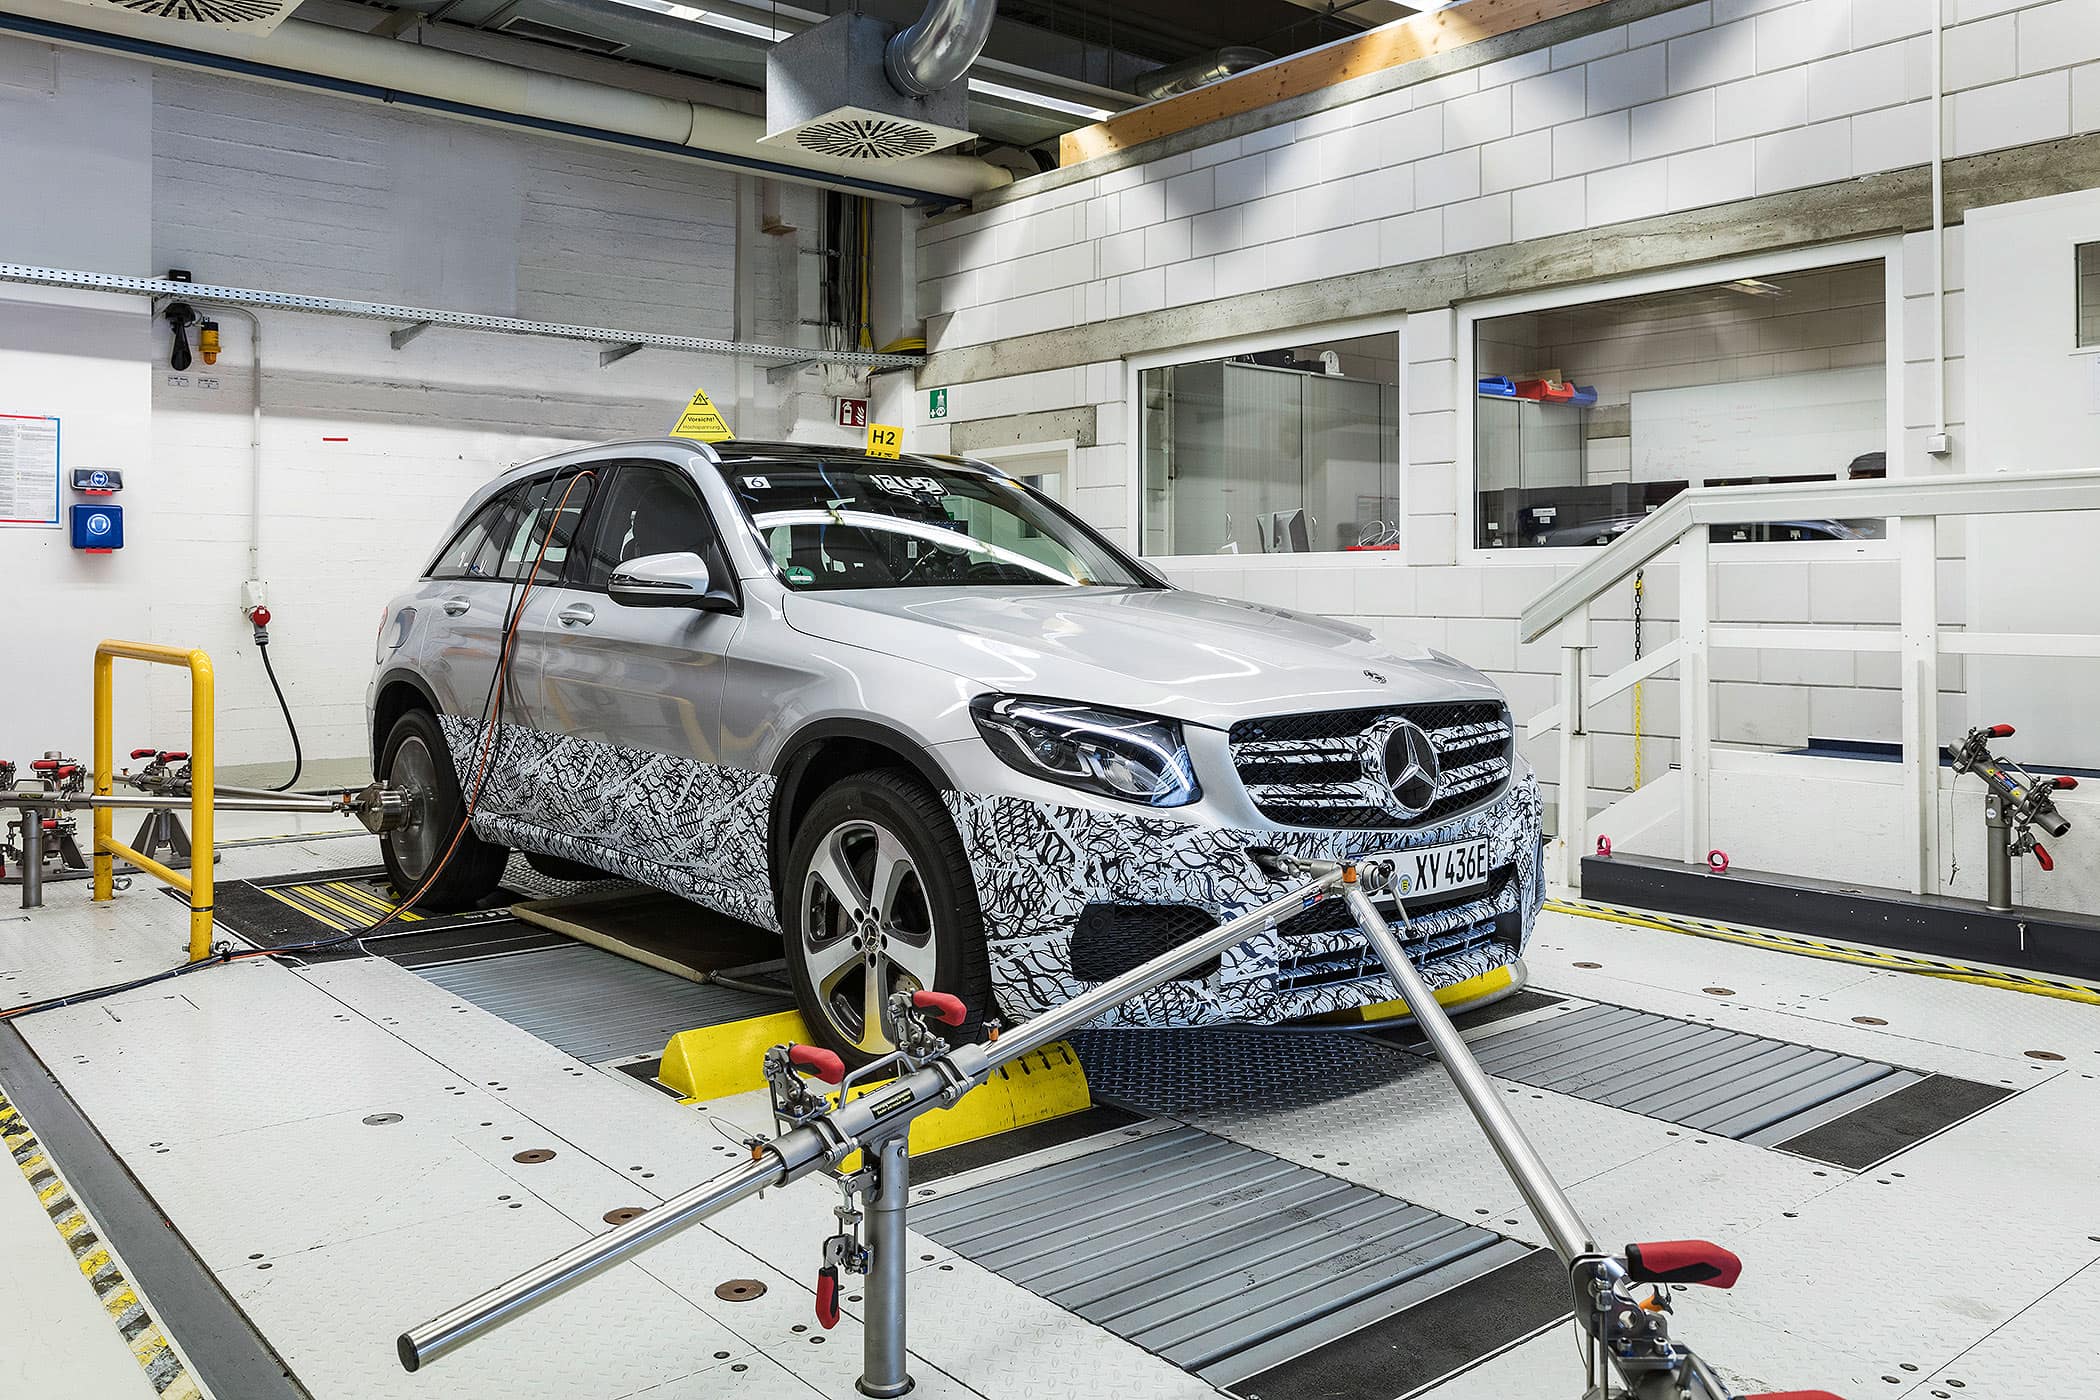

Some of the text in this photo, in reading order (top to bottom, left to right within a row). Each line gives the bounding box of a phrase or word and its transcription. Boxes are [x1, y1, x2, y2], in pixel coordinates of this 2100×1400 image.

[872, 429, 896, 445] H2
[751, 477, 764, 488] 6
[795, 567, 804, 577] 4
[1415, 852, 1441, 891] XY
[1445, 844, 1486, 885] 436E
